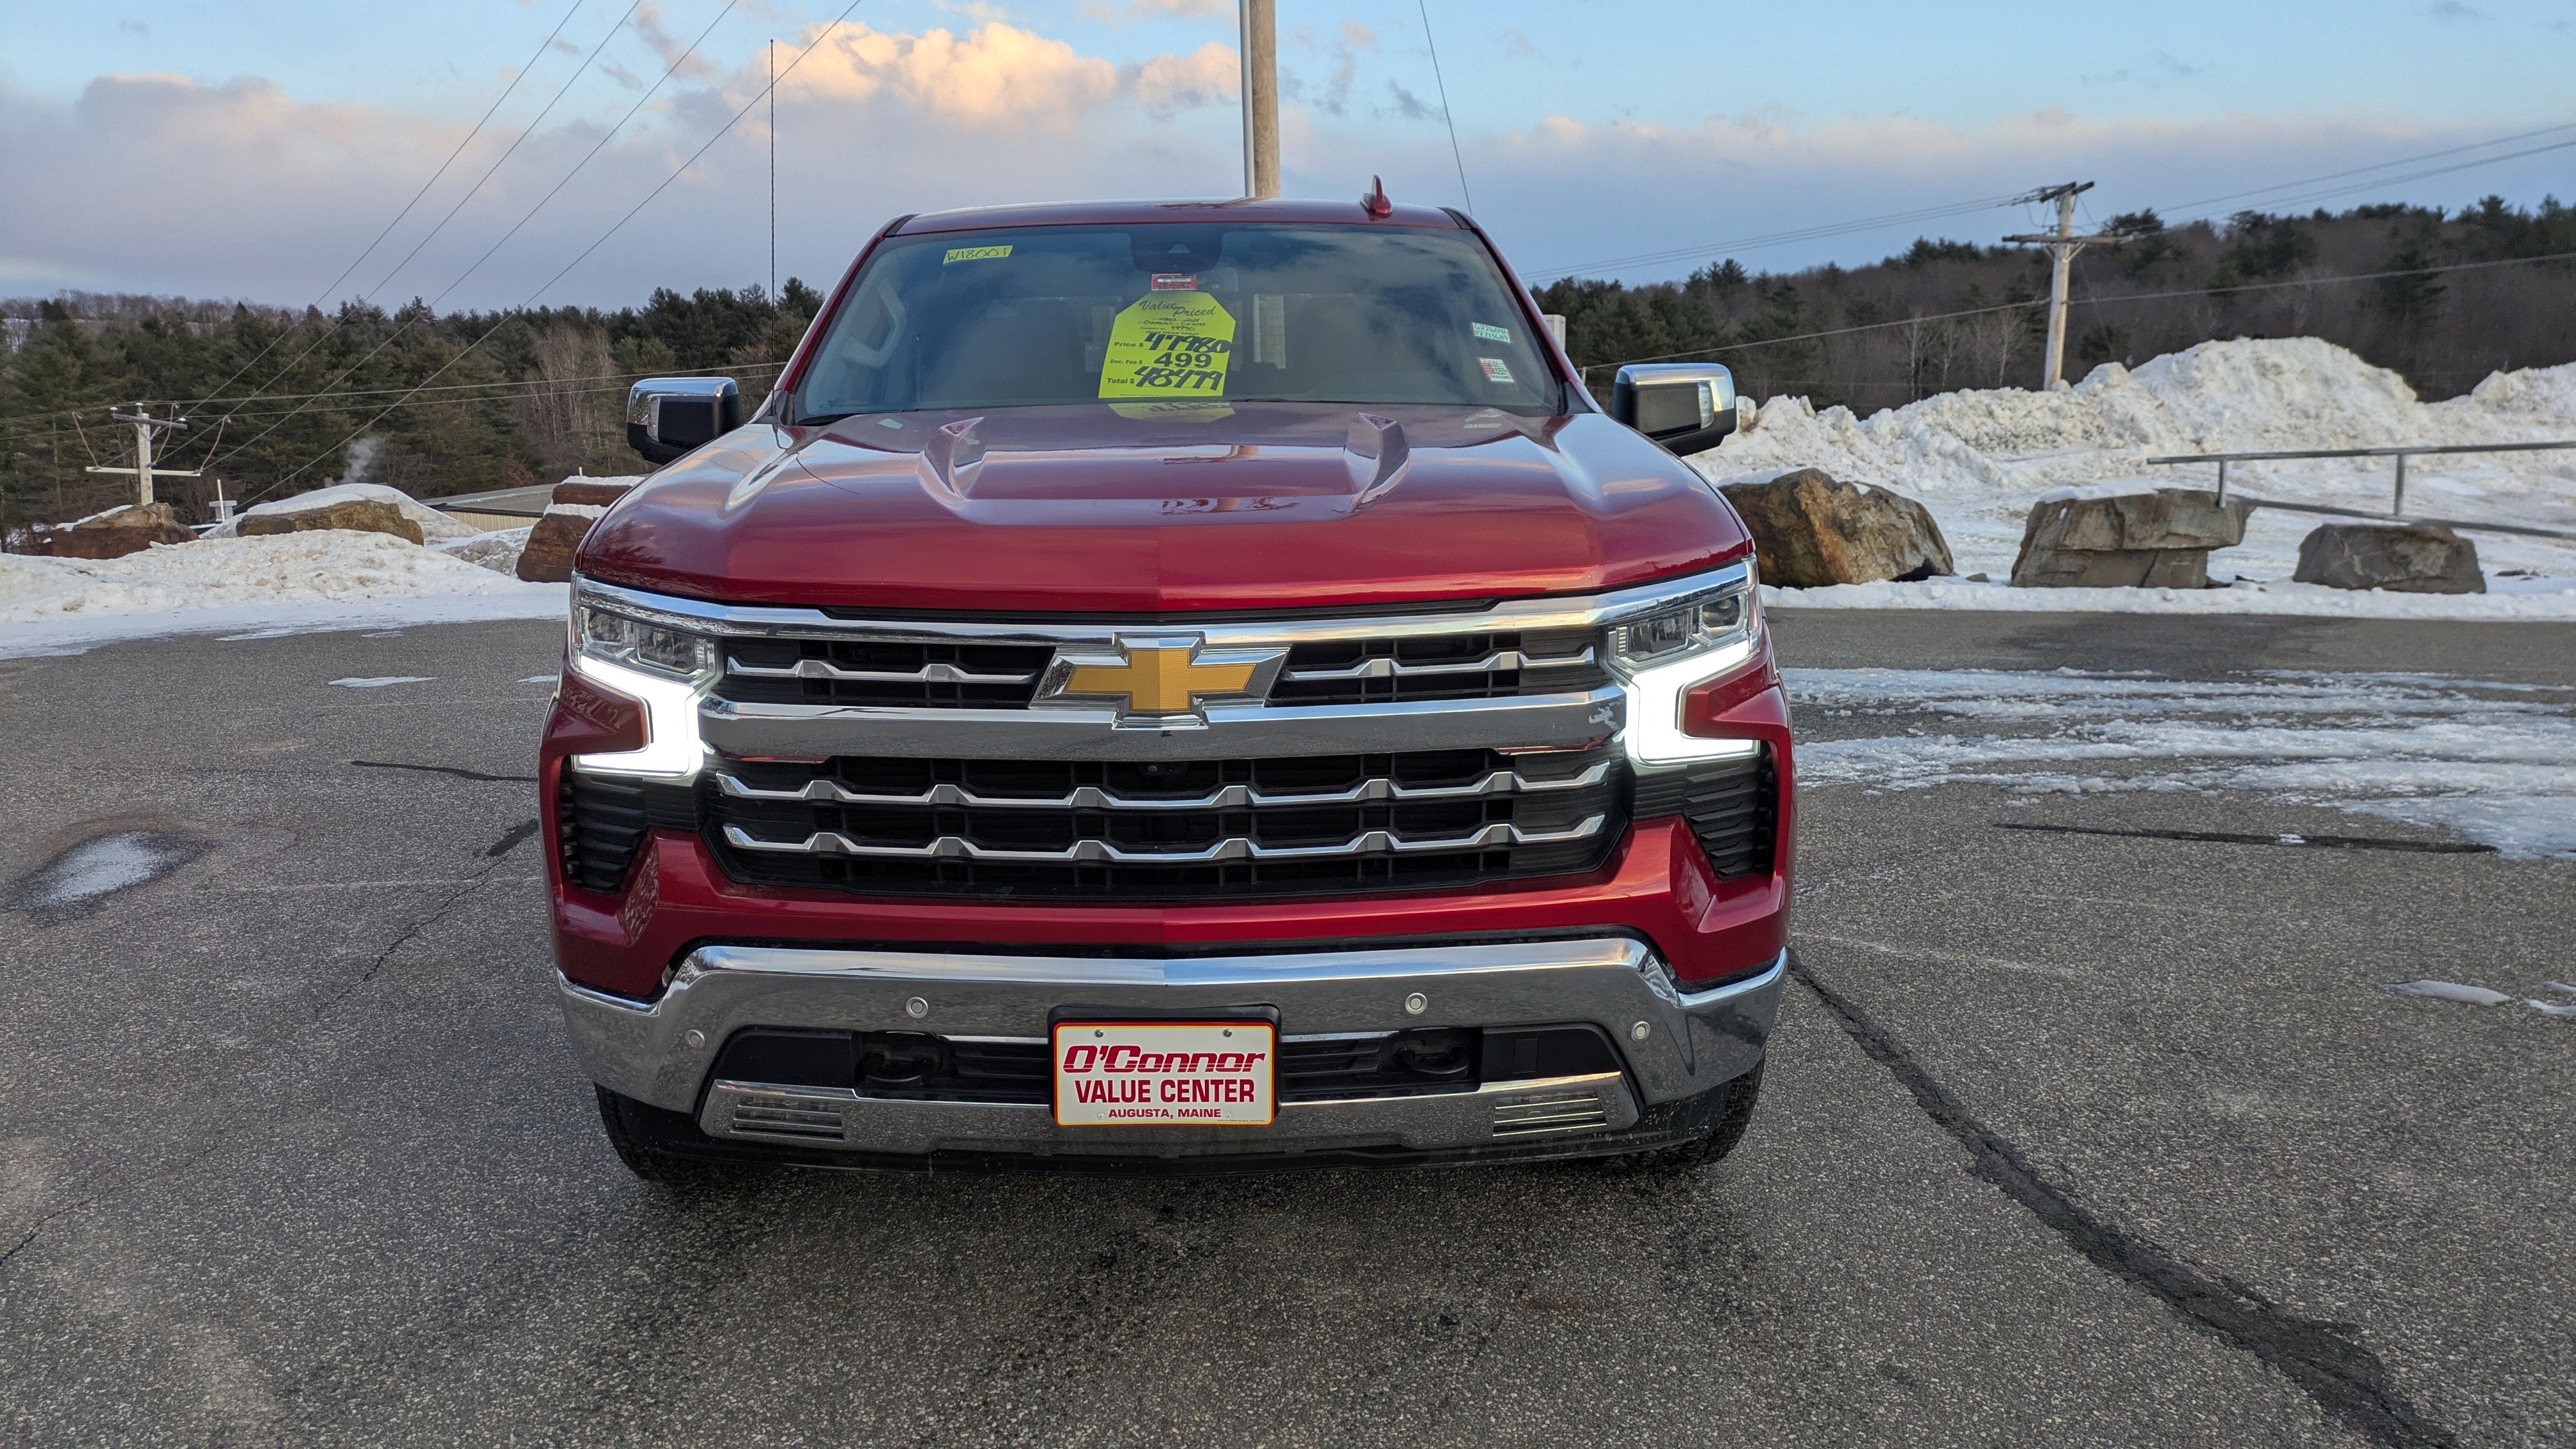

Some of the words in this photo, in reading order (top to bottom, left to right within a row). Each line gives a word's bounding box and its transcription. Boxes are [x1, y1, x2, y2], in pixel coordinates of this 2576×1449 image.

[1139, 300, 1177, 310] Value
[1172, 306, 1216, 318] Priced
[1154, 352, 1213, 368] 499
[1063, 1045, 1266, 1073] O'Connor
[1075, 1080, 1151, 1103] VALUE
[1160, 1079, 1255, 1103] CENTER
[1108, 1108, 1174, 1119] AUGUSTA,
[1177, 1108, 1222, 1117] MAINE
